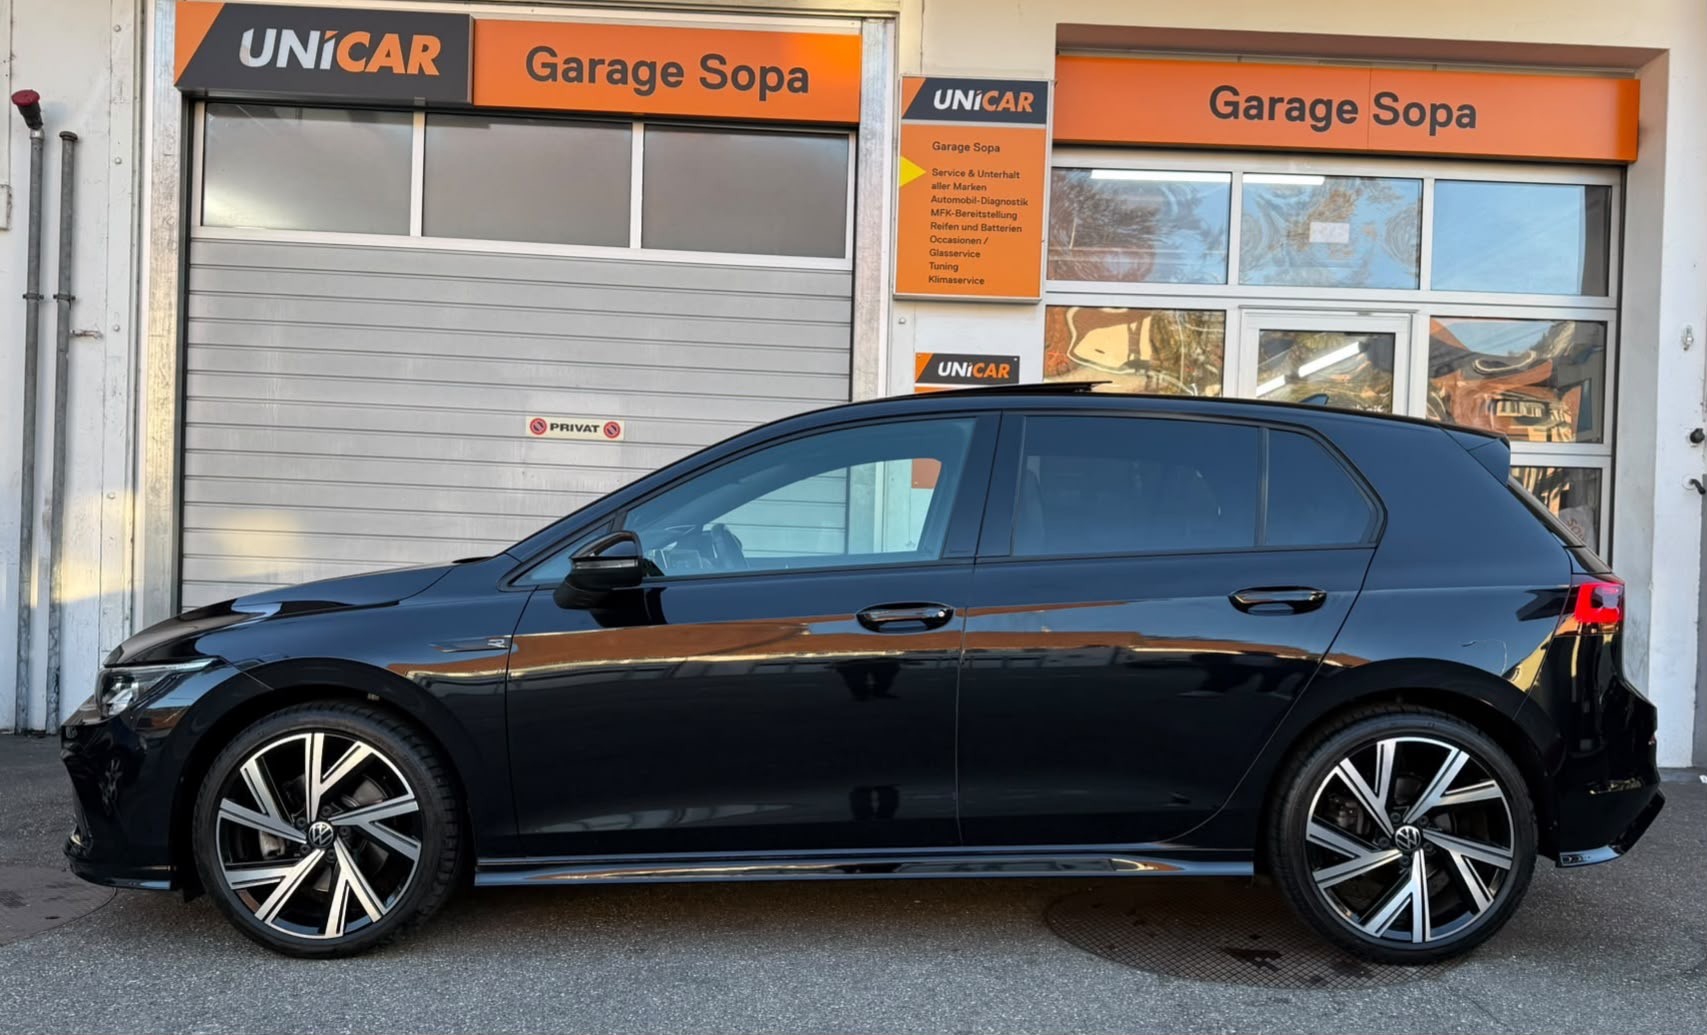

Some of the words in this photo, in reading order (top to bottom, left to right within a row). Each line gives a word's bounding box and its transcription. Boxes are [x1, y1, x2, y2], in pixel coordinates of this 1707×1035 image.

[526, 45, 684, 96] Garage
[699, 53, 809, 101] Sopa
[1209, 85, 1358, 132] Garage
[1372, 91, 1477, 136] Sopa
[932, 141, 970, 153] Garage
[973, 142, 1000, 154] Sopa
[931, 168, 966, 177] Service
[968, 169, 975, 177] &
[977, 169, 1020, 179] Unterhalt
[931, 182, 951, 190] aller
[953, 182, 987, 191] Marken
[930, 195, 1028, 207] Automobil-Diagnostik
[930, 208, 1018, 221] MFK-Bereitstellung
[930, 222, 959, 231] Reifen
[961, 223, 978, 231] und
[981, 223, 1022, 233] Batterien
[929, 235, 982, 244] Occasionen
[983, 237, 989, 245] /
[929, 248, 981, 258] Glasservice
[929, 262, 959, 272] Tuning
[928, 275, 985, 285] Klimaservice
[549, 423, 600, 433] PRIVAT
